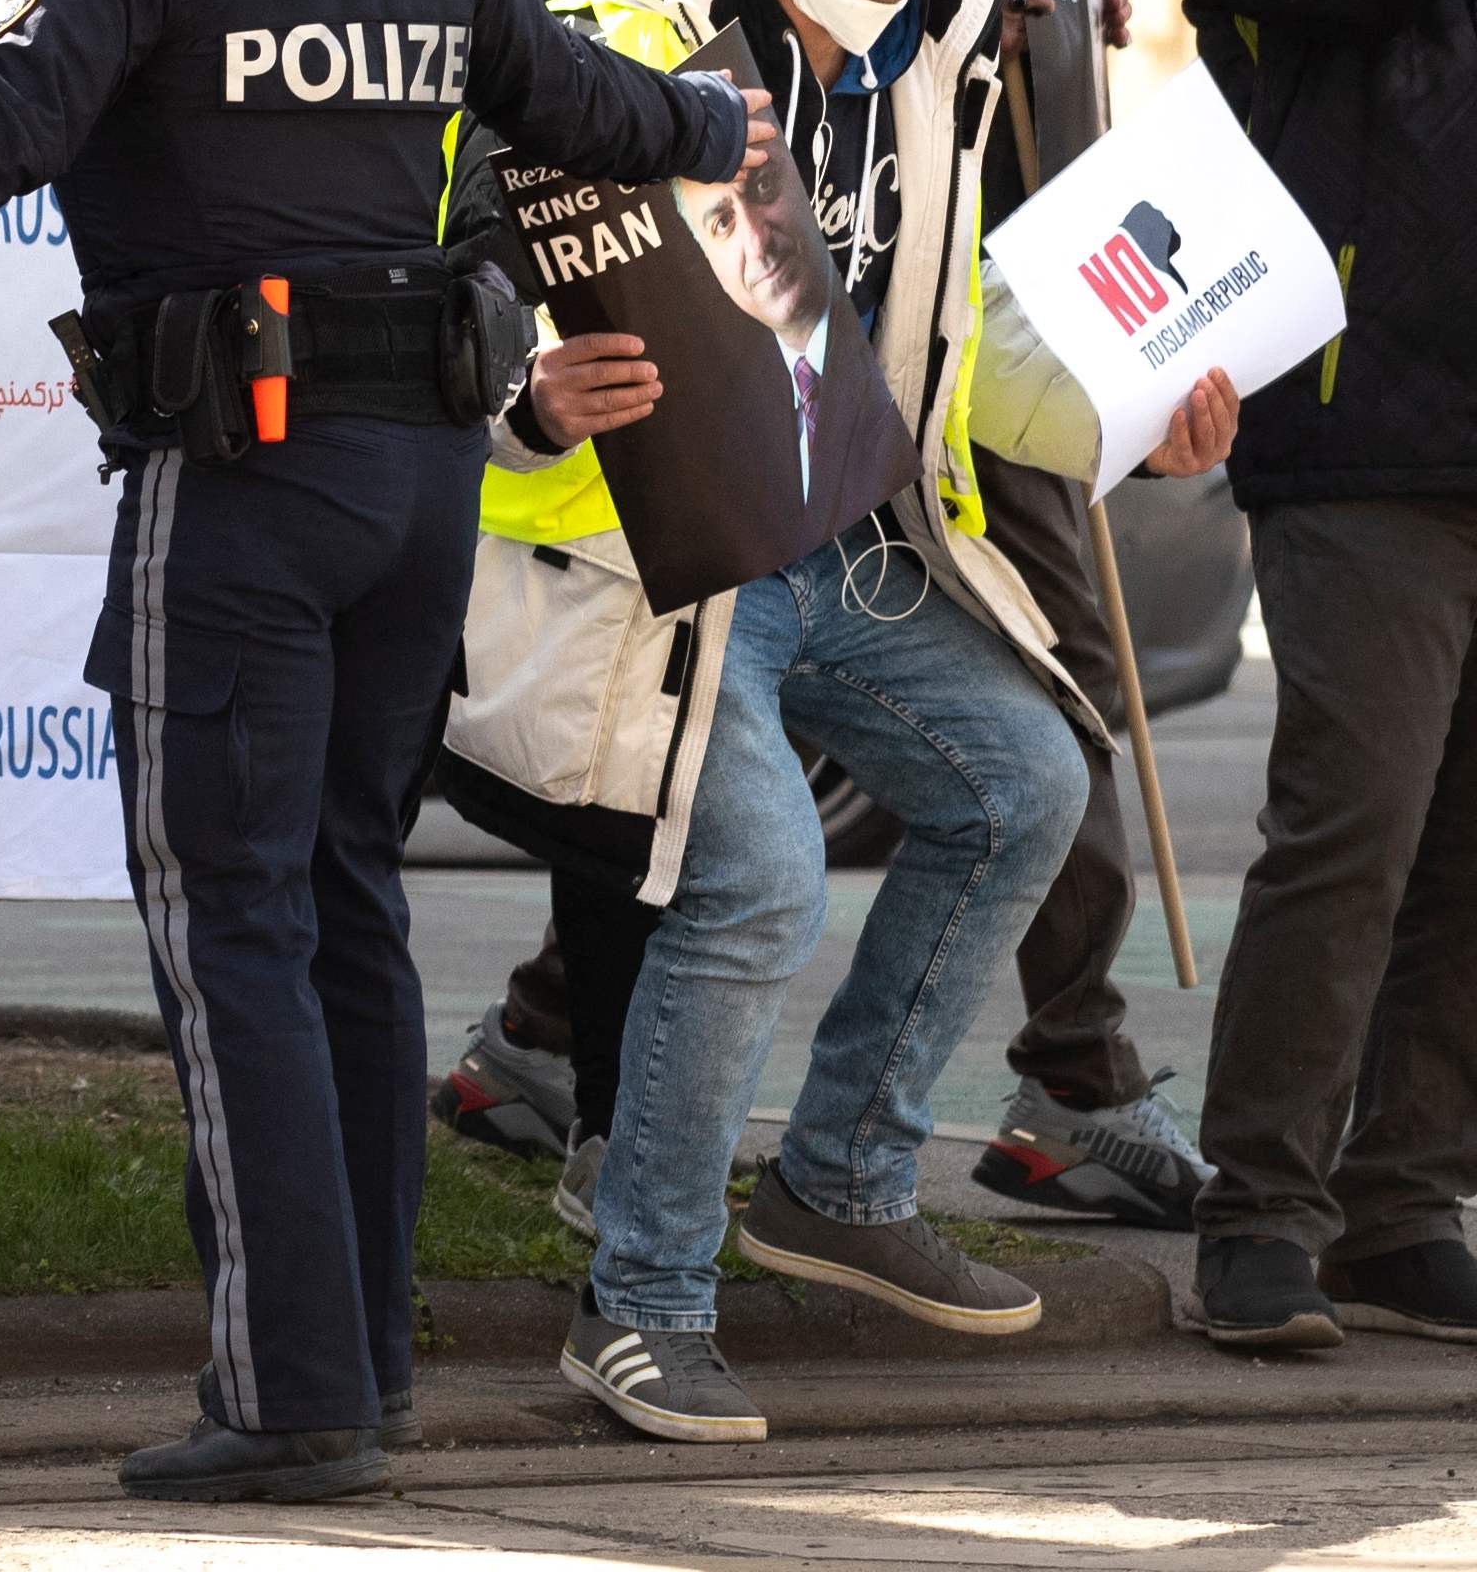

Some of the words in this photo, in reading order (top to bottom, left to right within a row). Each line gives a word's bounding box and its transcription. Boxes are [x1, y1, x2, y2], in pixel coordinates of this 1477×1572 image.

[226, 23, 470, 102] POLIZE
[518, 186, 601, 229] KING
[532, 202, 662, 286] IRAN
[1078, 234, 1169, 336] NO
[1156, 299, 1213, 357] ISLAMIC
[1203, 250, 1268, 316] REPUBLIC
